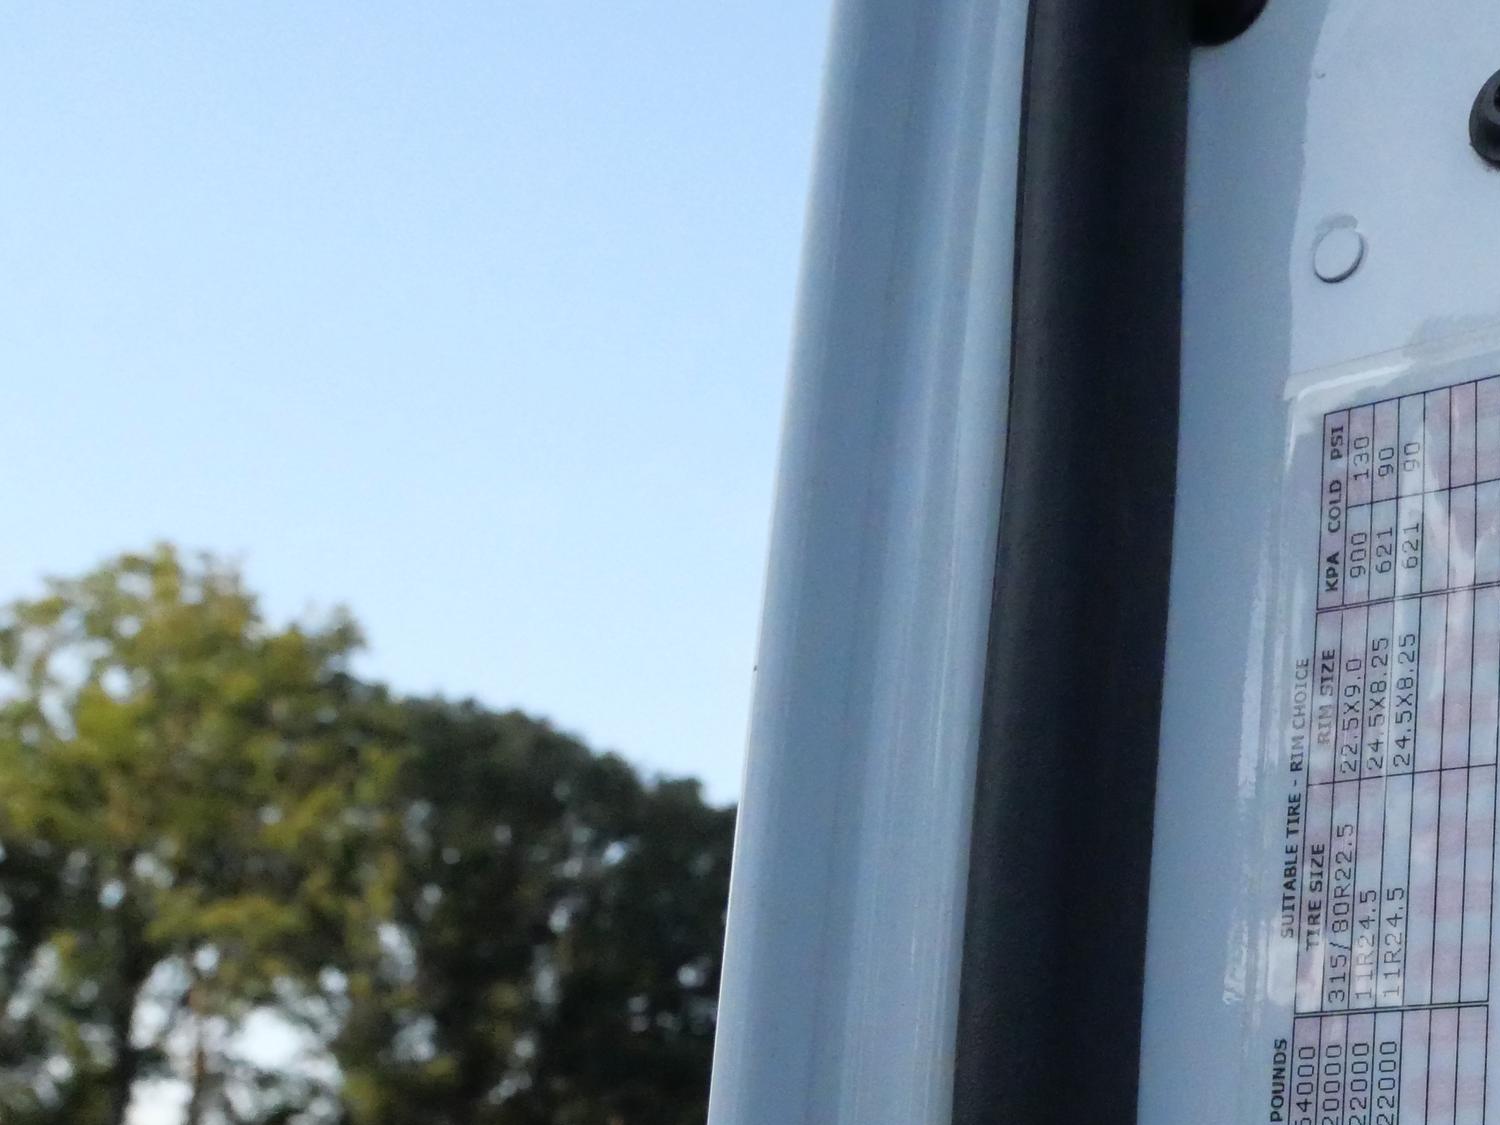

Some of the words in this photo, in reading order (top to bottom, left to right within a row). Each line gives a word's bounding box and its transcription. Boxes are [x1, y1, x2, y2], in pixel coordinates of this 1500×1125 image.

[1330, 424, 1344, 460] PSI
[1352, 436, 1370, 481] 130
[1377, 446, 1394, 477] 90
[1404, 441, 1421, 472] 90
[1327, 479, 1342, 533] COLD
[1349, 532, 1367, 578] 900
[1376, 526, 1393, 574] 621
[1401, 522, 1419, 569] 621
[1324, 551, 1339, 592] KPA
[1292, 658, 1309, 729] CHOICE
[1319, 649, 1336, 696] SIZE
[1340, 658, 1362, 774] 22.5X9.0
[1393, 632, 1416, 767] 24.5X8.25
[1316, 704, 1331, 744] RIM
[1289, 734, 1304, 772] RIM
[1286, 793, 1301, 838] TIRE
[1355, 889, 1377, 1000] 11R24.5
[1367, 637, 1389, 770] 24.5X8.25
[1280, 844, 1298, 939] SUITABLE
[1308, 843, 1324, 893] SIZE
[1306, 900, 1322, 952] TIRE
[1383, 886, 1405, 997] 11R24.5
[1270, 1038, 1287, 1123] POUNDS
